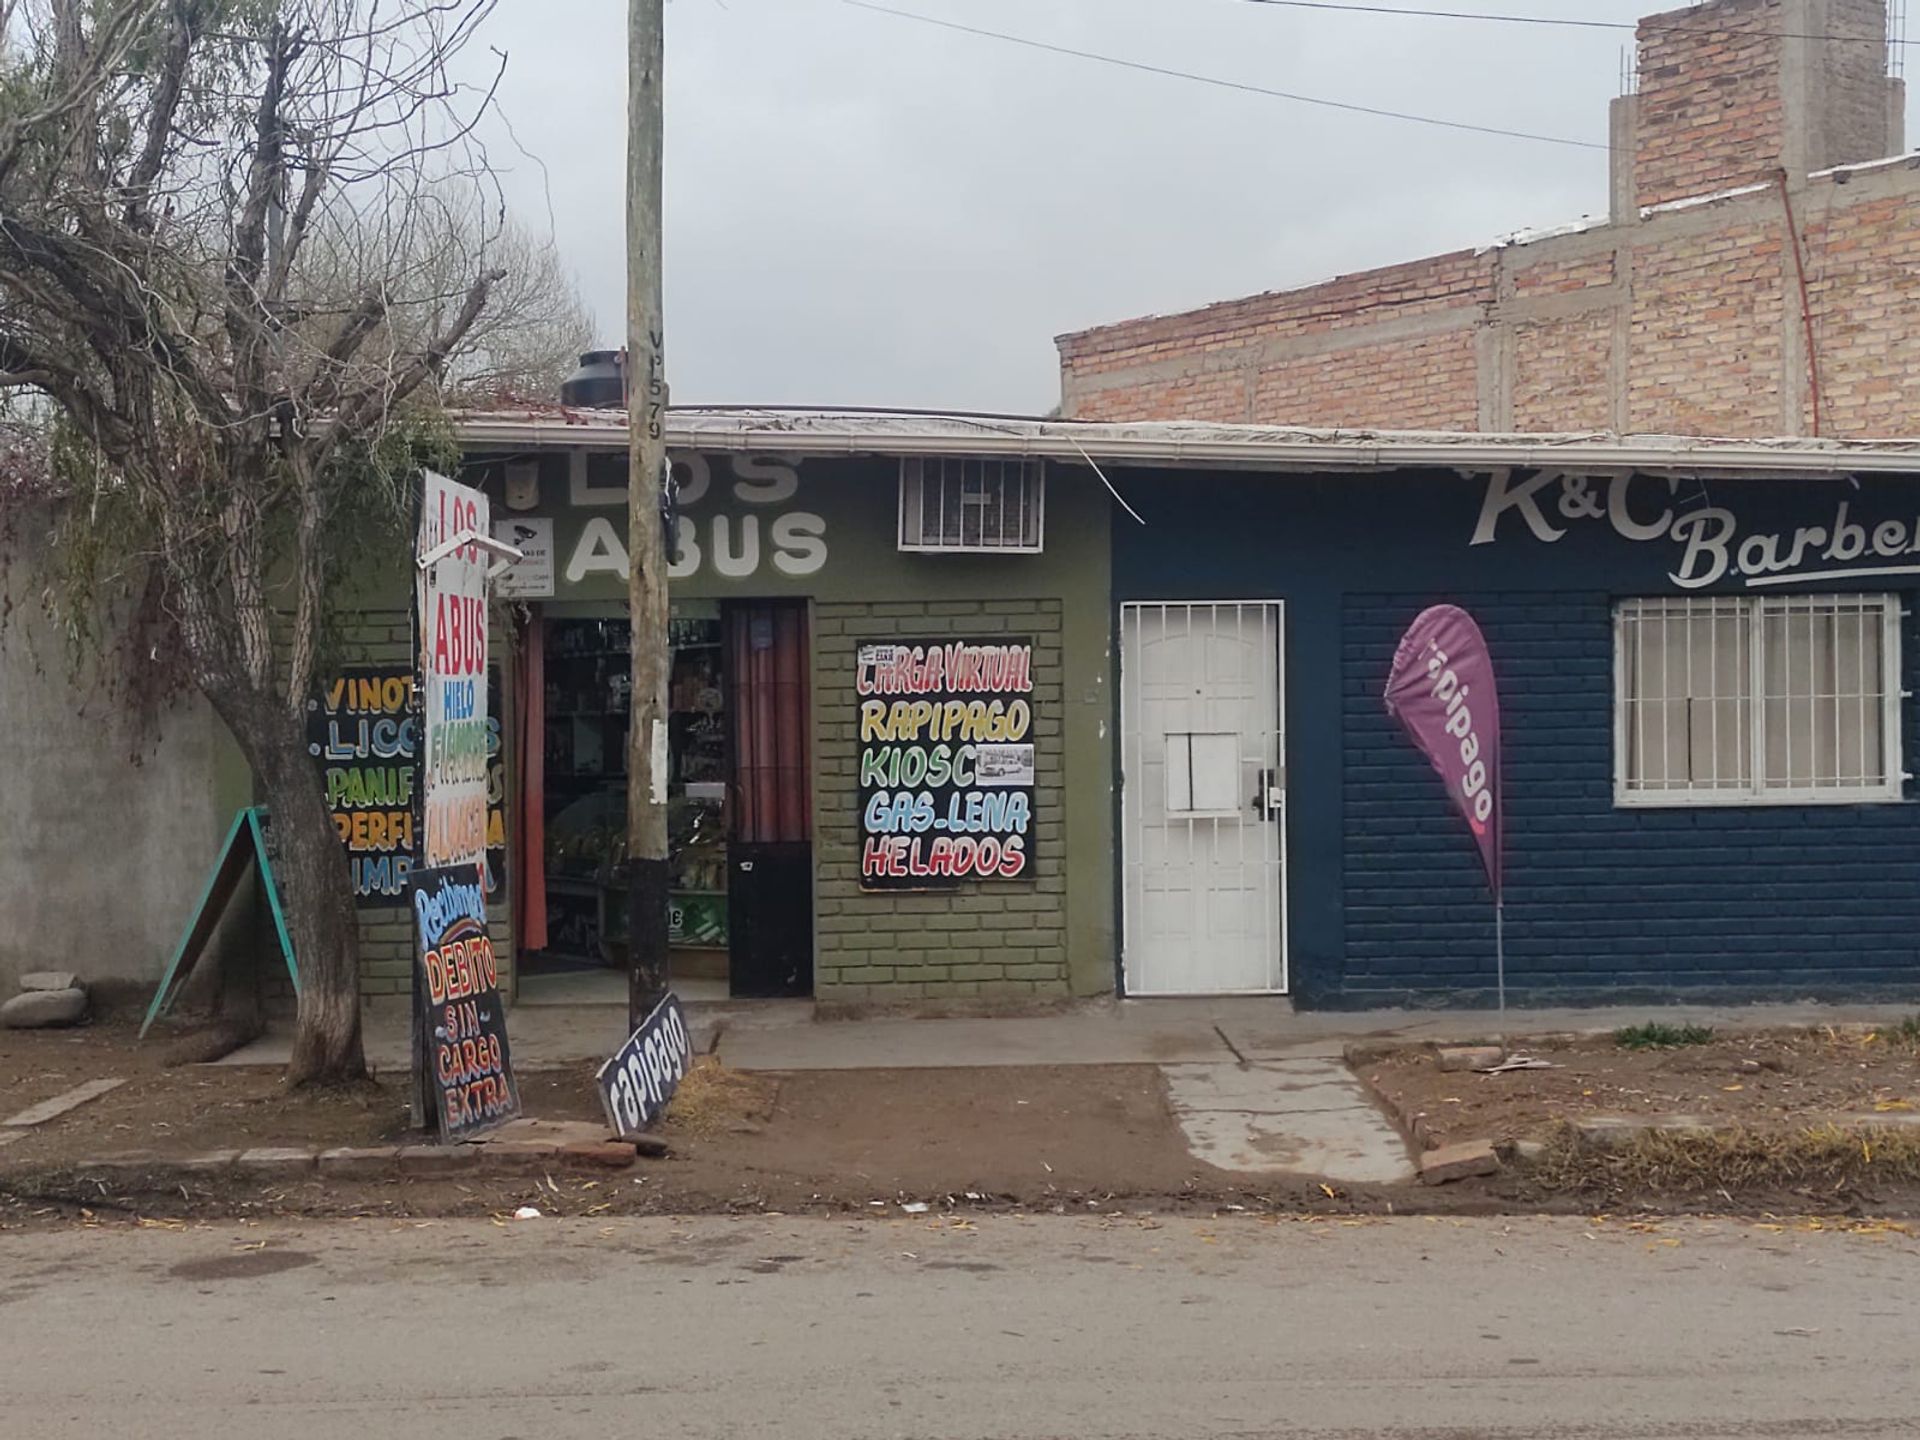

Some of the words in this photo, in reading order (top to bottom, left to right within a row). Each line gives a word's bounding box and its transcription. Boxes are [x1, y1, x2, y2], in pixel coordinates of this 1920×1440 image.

[435, 592, 486, 676] ABUS
[945, 641, 1033, 692] VIRTUAL
[444, 679, 475, 722] HIELO
[861, 699, 1030, 742] RAPIPAGO
[861, 744, 978, 788] KIOSC
[862, 836, 1026, 877] HELADOS
[424, 935, 497, 1005] DEBITO
[445, 1000, 481, 1043] SIN
[437, 1033, 501, 1088] CARGO
[610, 1006, 687, 1136] rapipago
[444, 1072, 513, 1128] EXTRA
